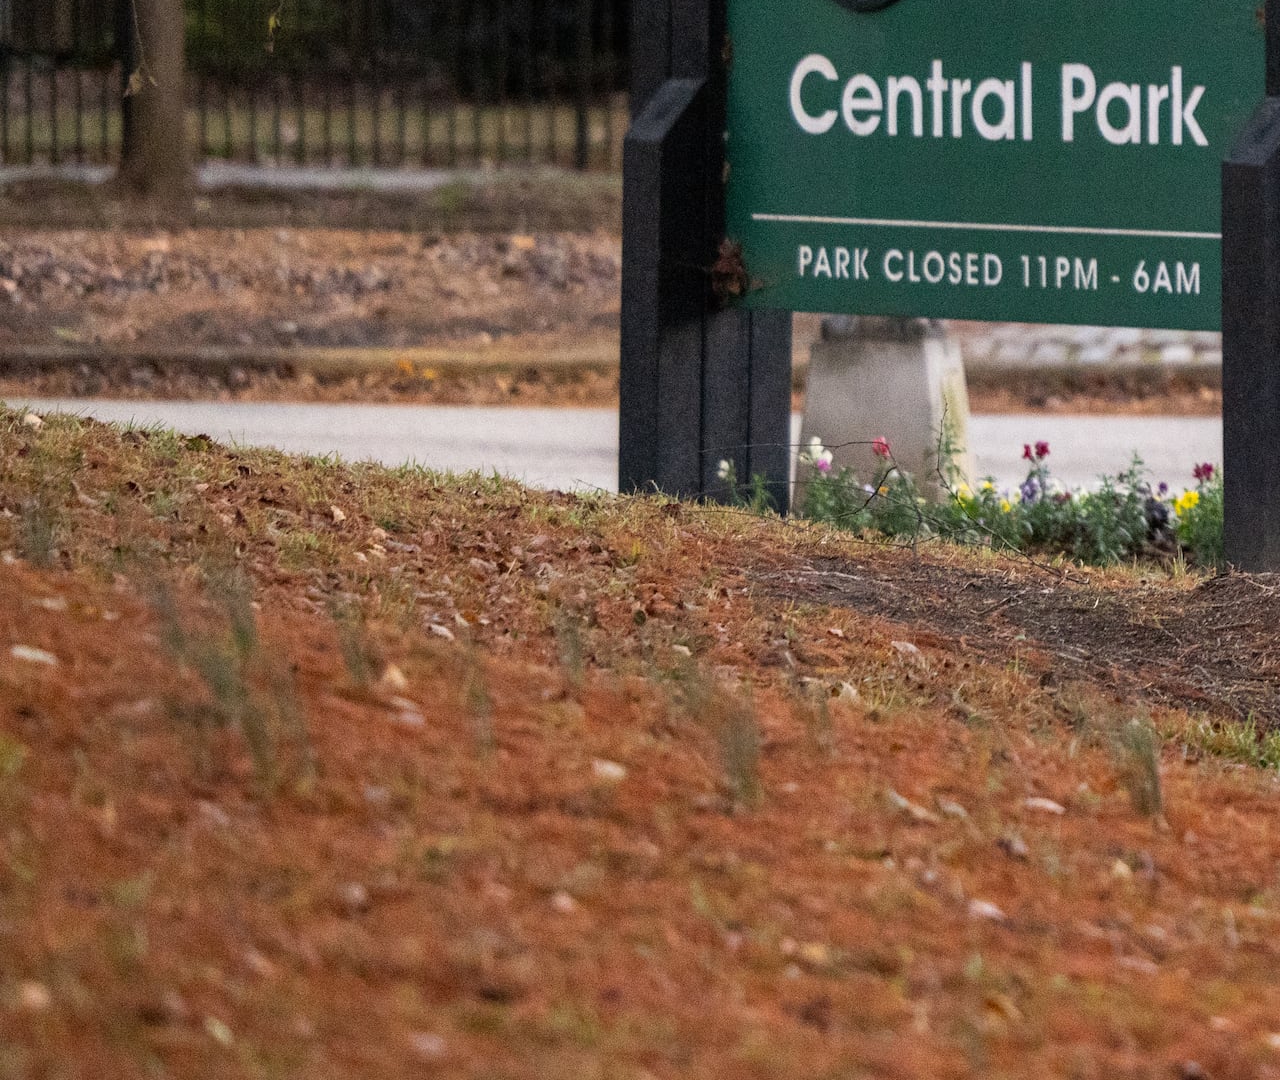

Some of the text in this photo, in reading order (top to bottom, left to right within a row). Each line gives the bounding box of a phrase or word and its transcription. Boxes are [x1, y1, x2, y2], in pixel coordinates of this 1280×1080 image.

[790, 54, 1209, 147] Central Park
[799, 245, 869, 280] PARK
[883, 249, 1003, 286] CLOSED
[1021, 255, 1098, 290] 11PM
[1133, 261, 1201, 295] 6AM
